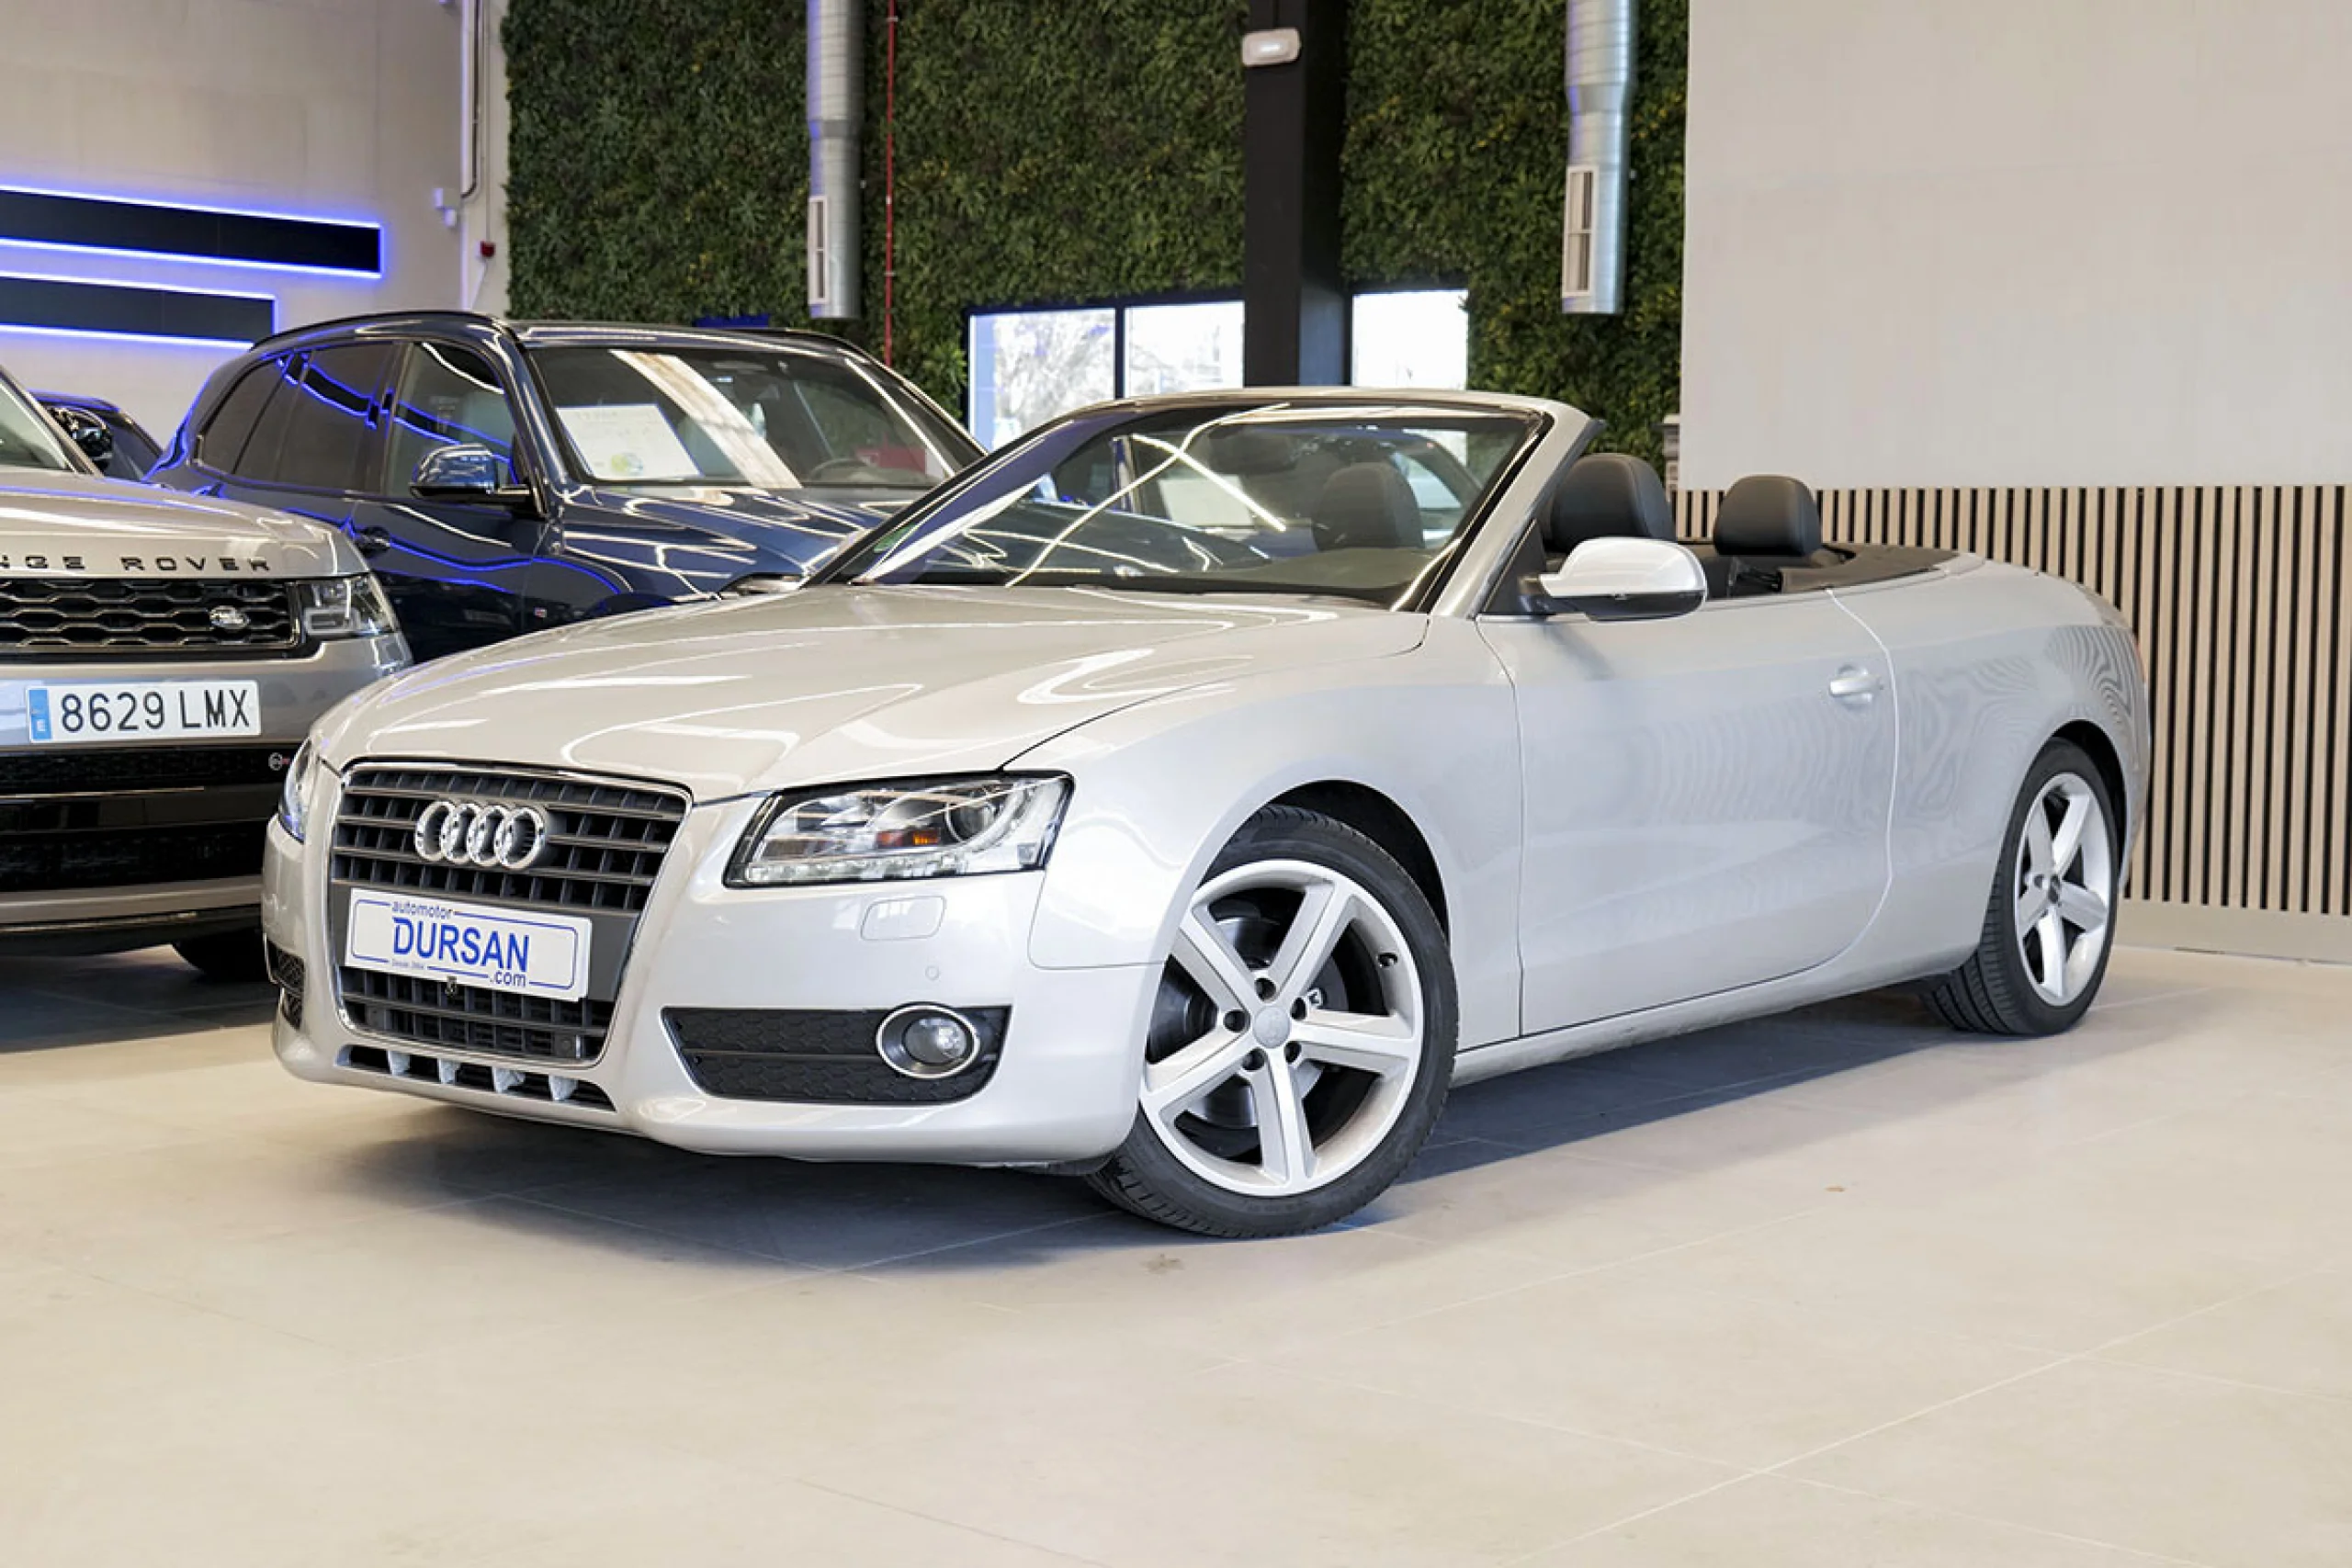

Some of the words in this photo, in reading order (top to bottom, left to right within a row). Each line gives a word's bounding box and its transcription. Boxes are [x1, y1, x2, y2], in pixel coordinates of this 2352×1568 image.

[120, 556, 270, 571] ROVER
[61, 691, 165, 733] 8629
[179, 689, 250, 728] LMX
[36, 718, 47, 732] E
[391, 900, 453, 919] automotor
[392, 917, 530, 973] DURSAN
[490, 969, 526, 987] .com
